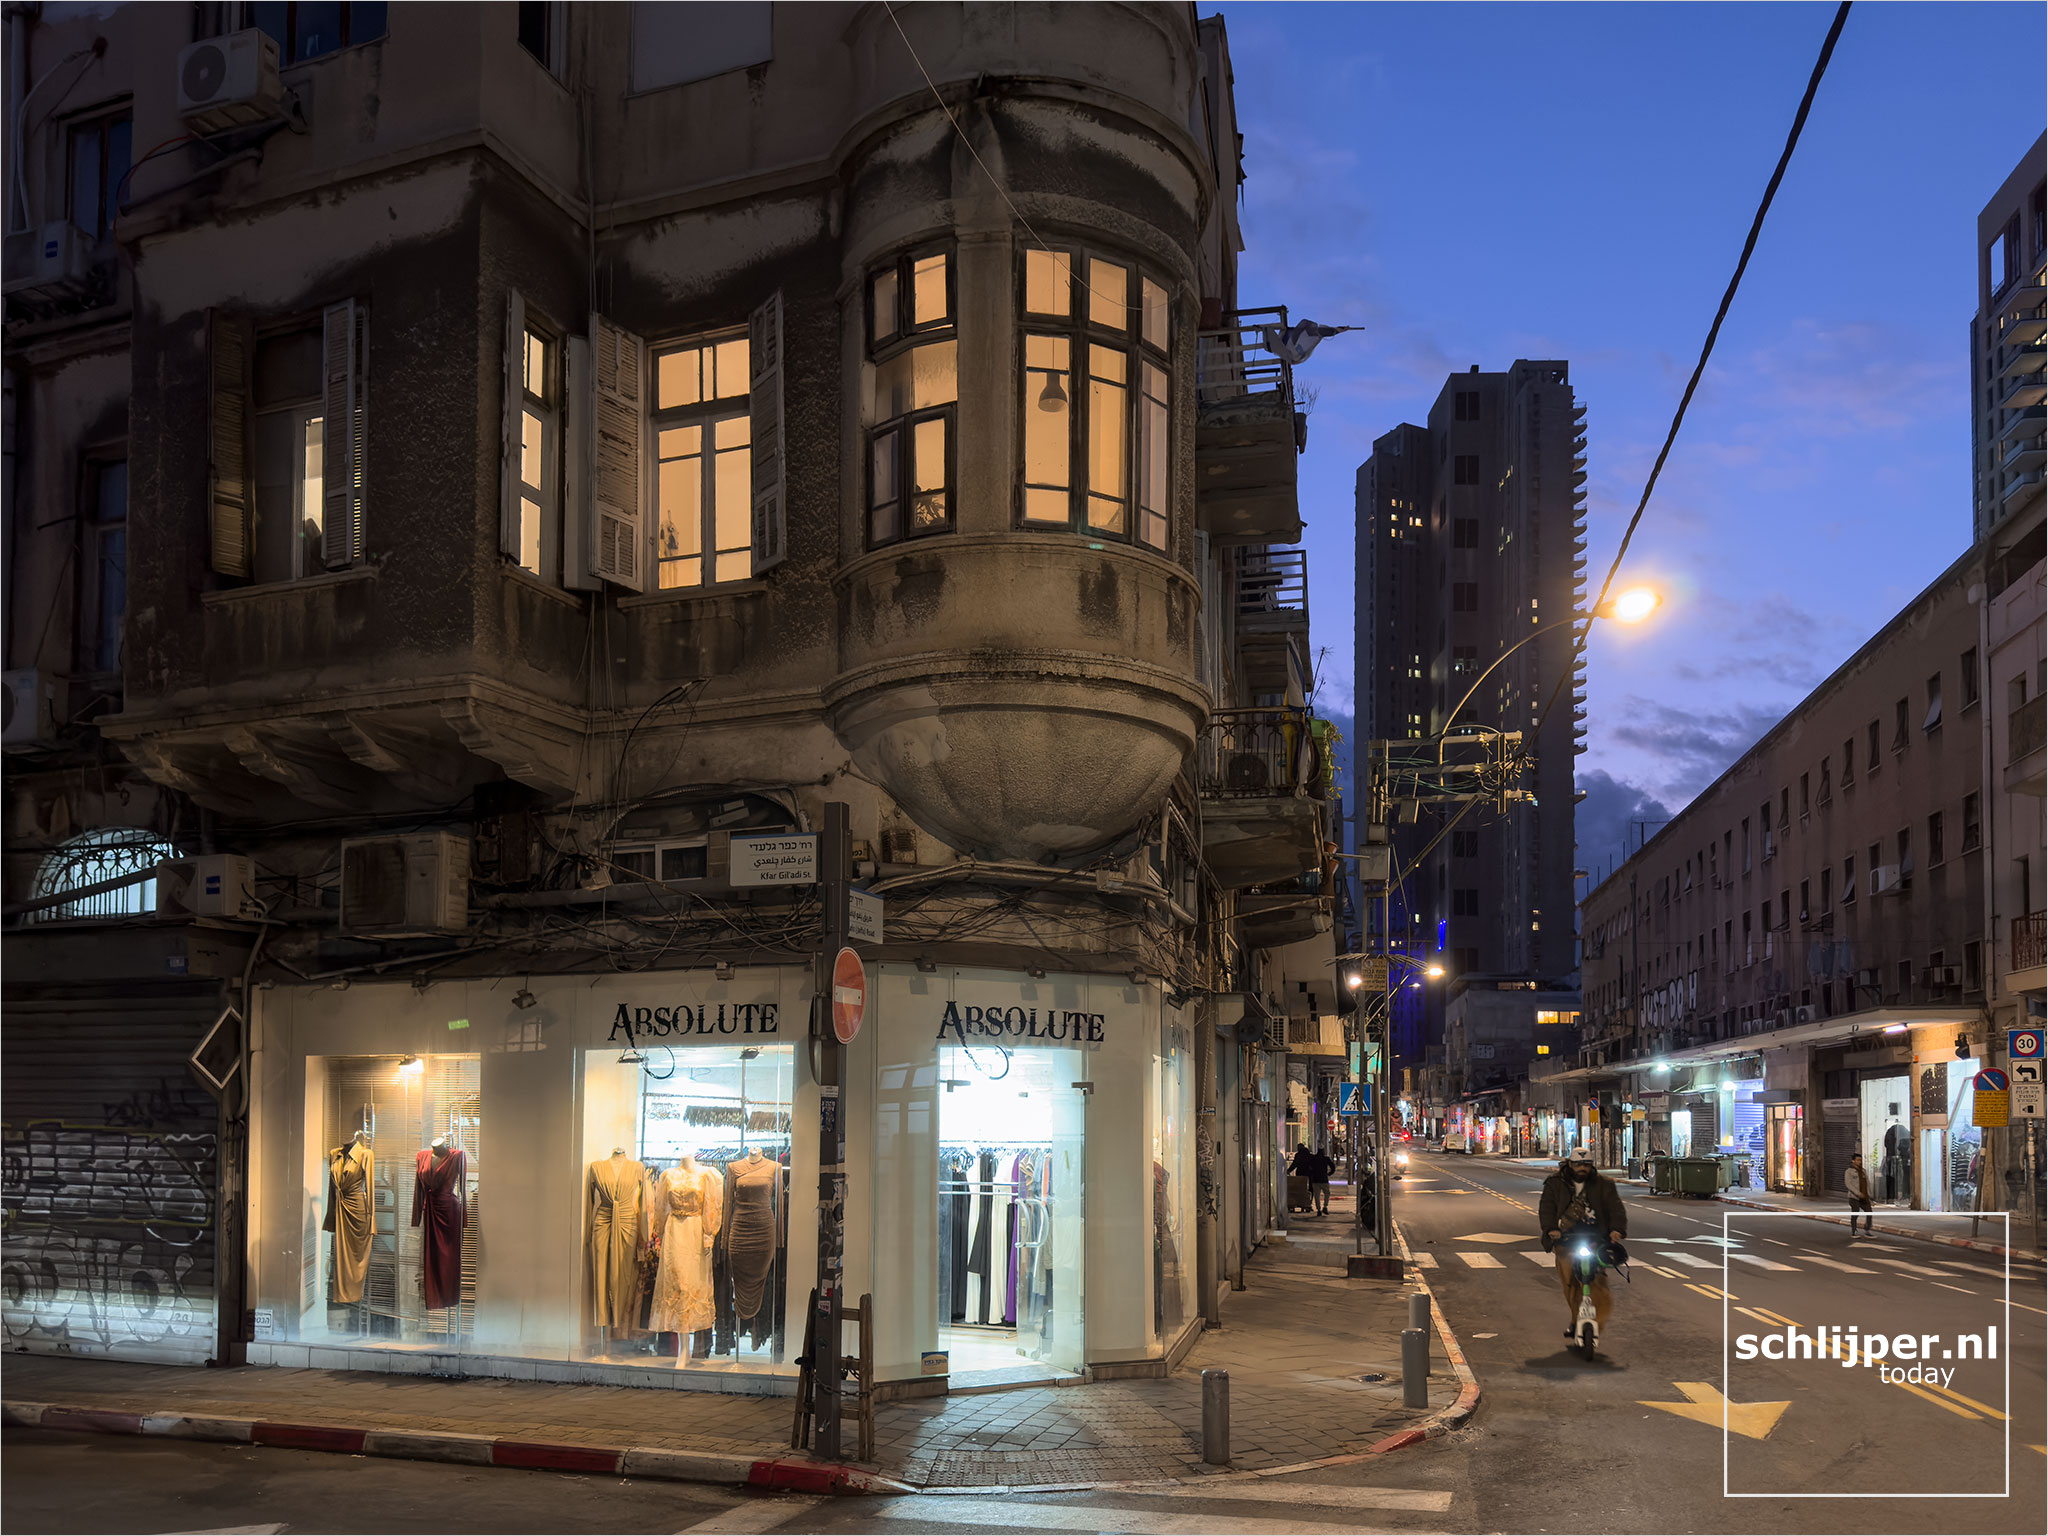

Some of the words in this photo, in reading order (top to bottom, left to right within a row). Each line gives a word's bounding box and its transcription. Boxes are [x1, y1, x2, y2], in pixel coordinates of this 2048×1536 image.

[749, 841, 777, 851] גלעדי
[778, 842, 797, 850] כפר
[797, 855, 813, 865] شارع
[760, 872, 777, 881] Kfar
[778, 870, 802, 880] Gil'adi
[608, 1003, 778, 1041] ABSOLUTE
[937, 1001, 1105, 1043] ABSOLUTE
[2018, 1038, 2034, 1050] 30
